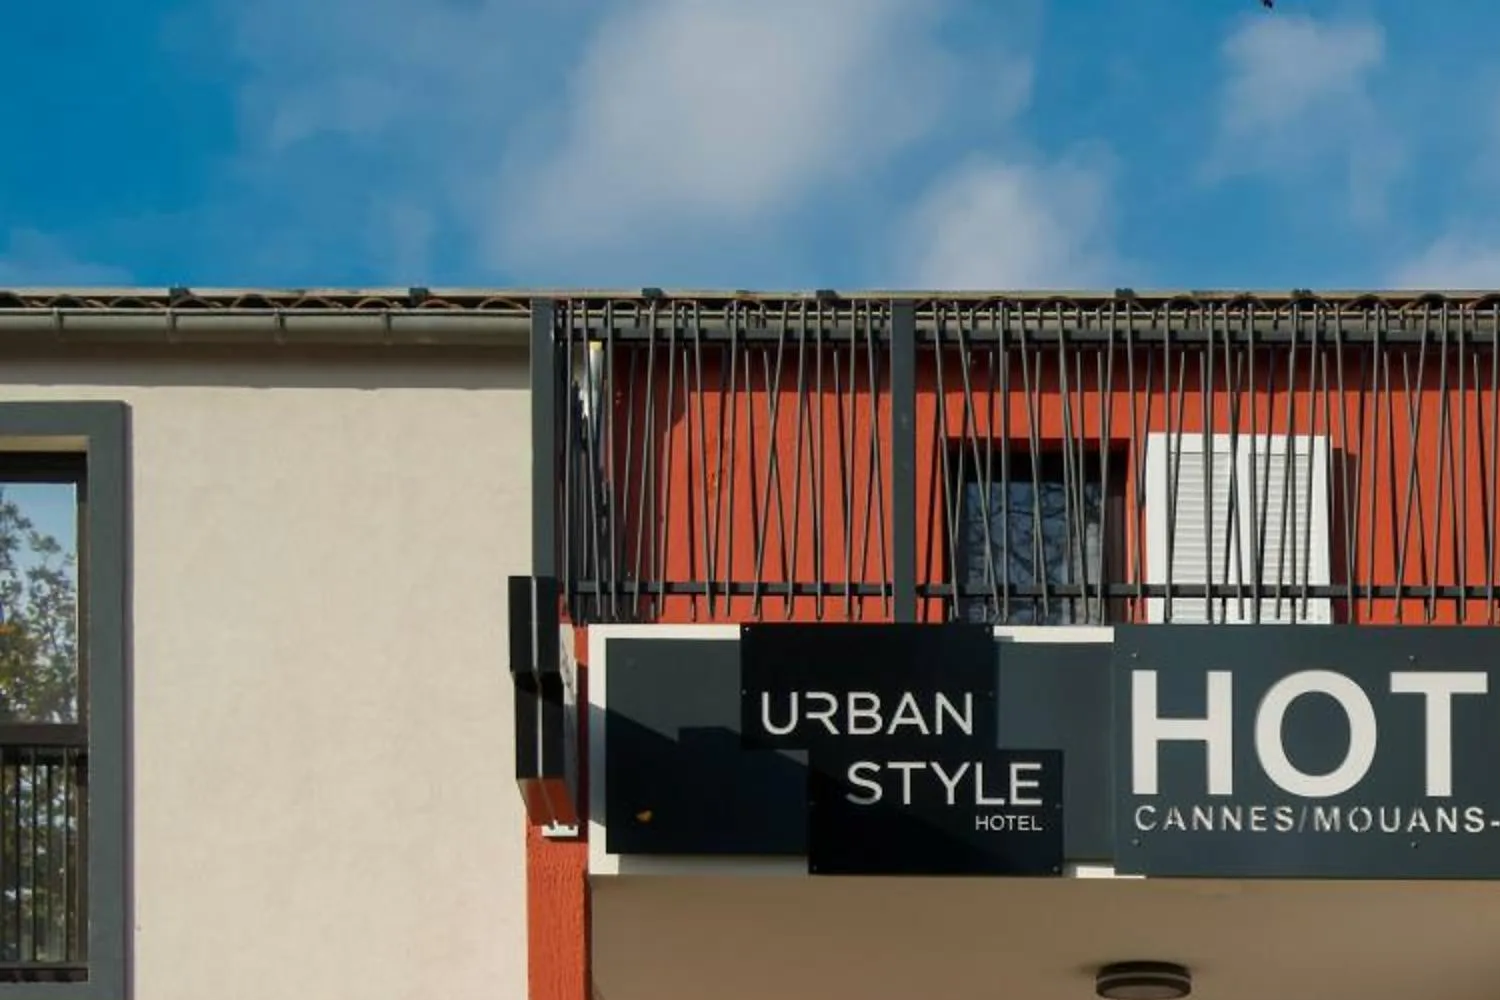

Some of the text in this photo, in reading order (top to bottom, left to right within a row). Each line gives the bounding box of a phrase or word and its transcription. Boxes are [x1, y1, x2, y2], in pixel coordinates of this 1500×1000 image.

[761, 691, 973, 736] URBAN
[846, 761, 1043, 806] STYLE
[975, 815, 1043, 831] HOTEL
